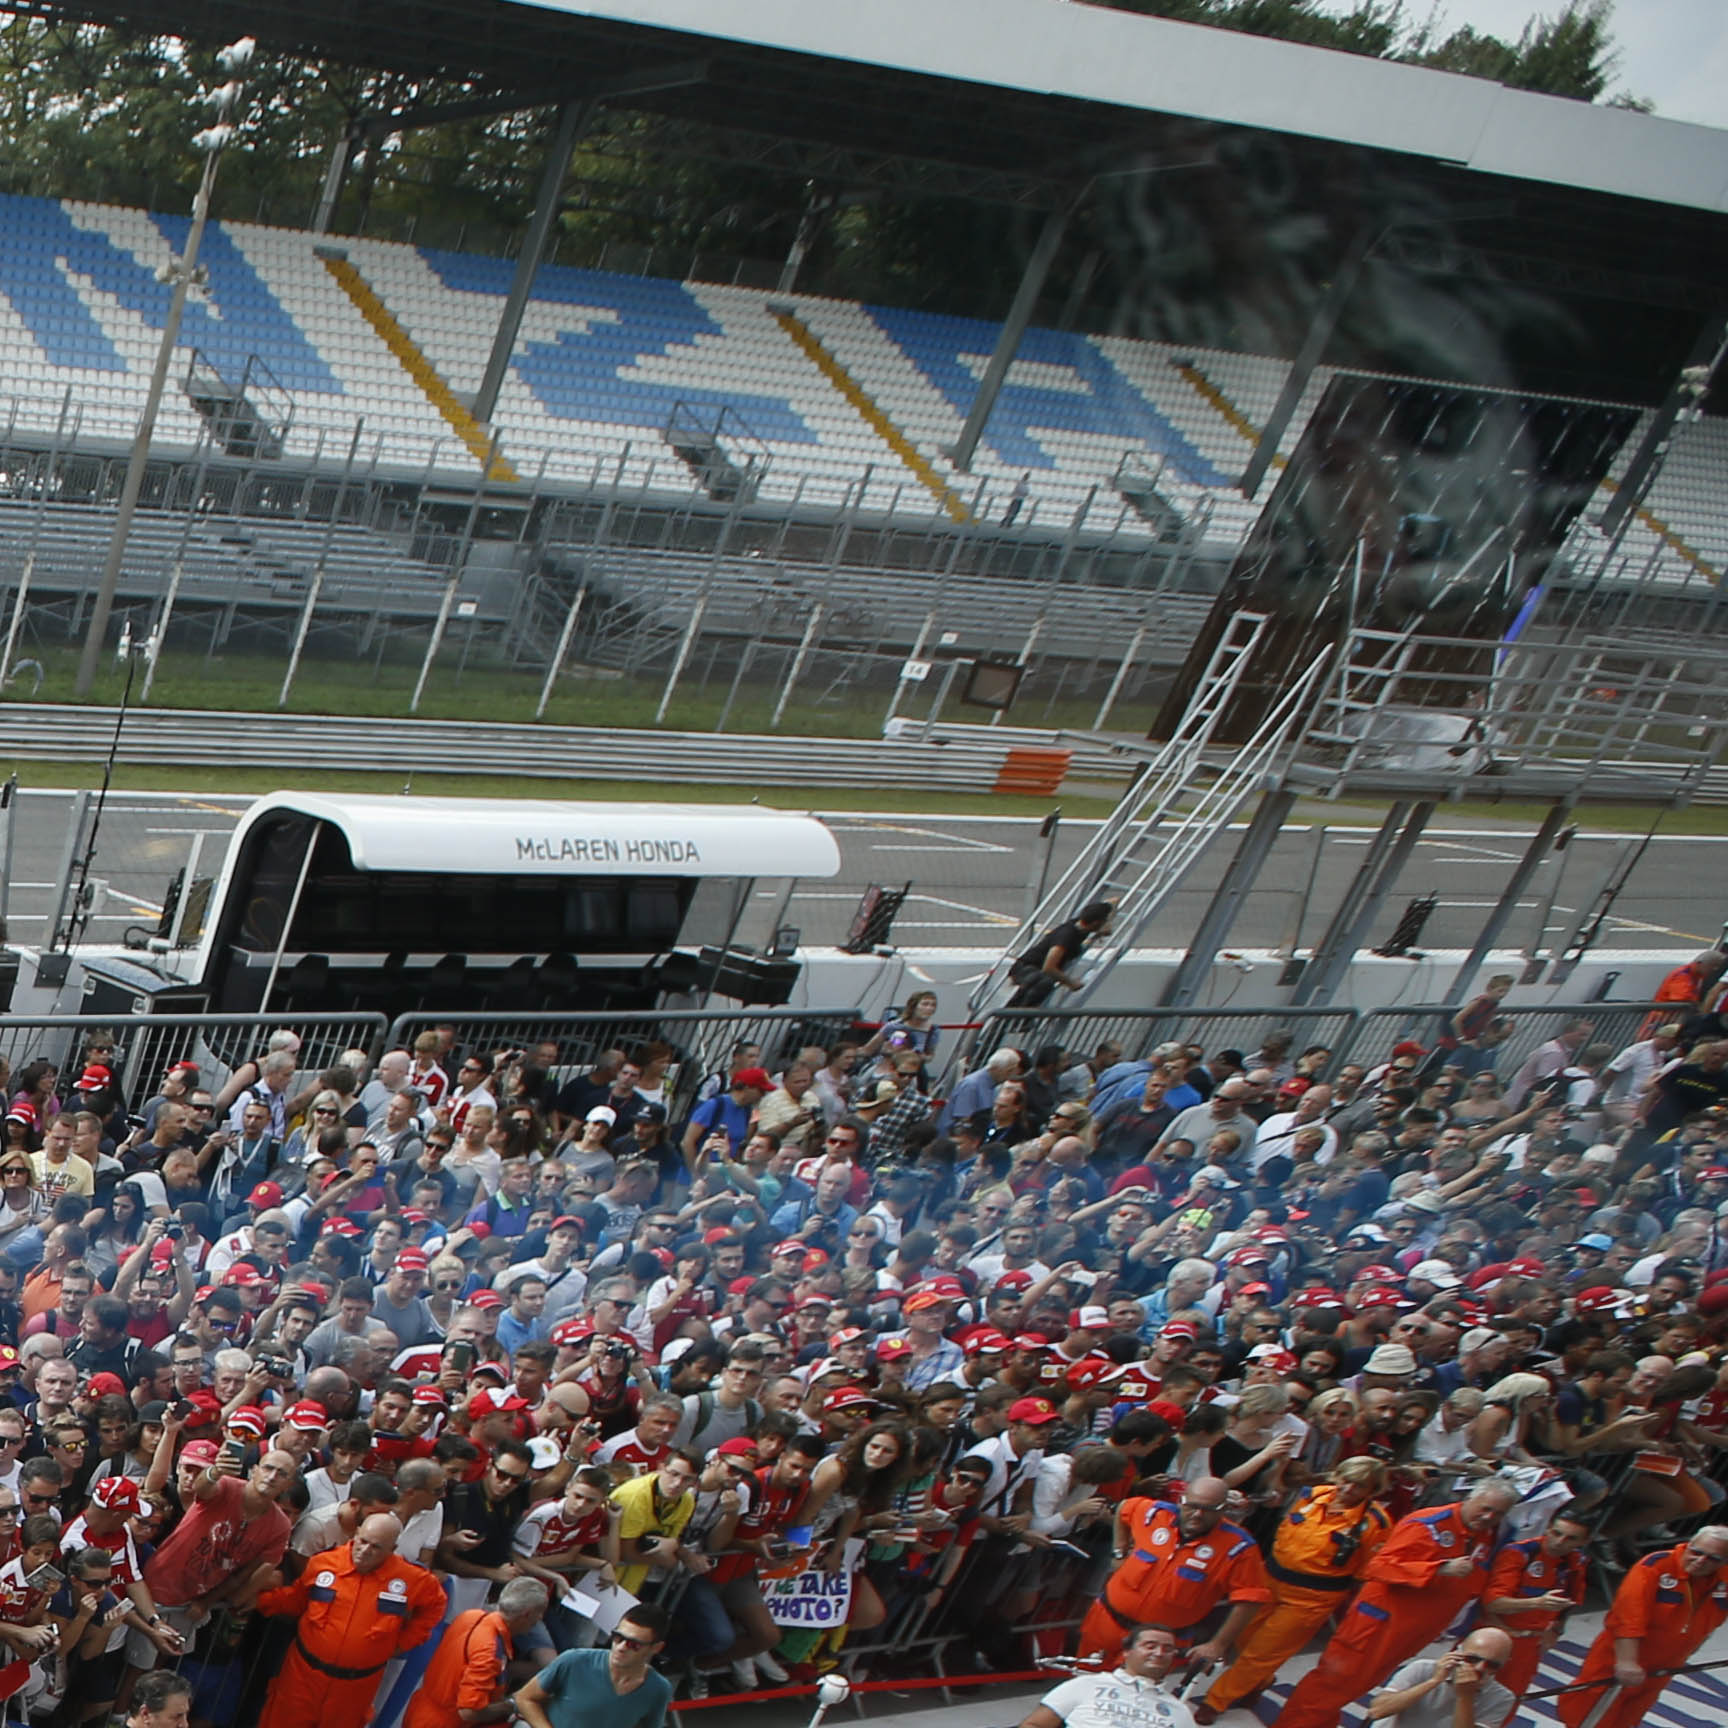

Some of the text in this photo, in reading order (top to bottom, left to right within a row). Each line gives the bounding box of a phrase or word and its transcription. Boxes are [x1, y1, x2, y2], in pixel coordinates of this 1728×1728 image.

[516, 838, 701, 865] McLAREN HONDA
[799, 1572, 848, 1595] TAKE
